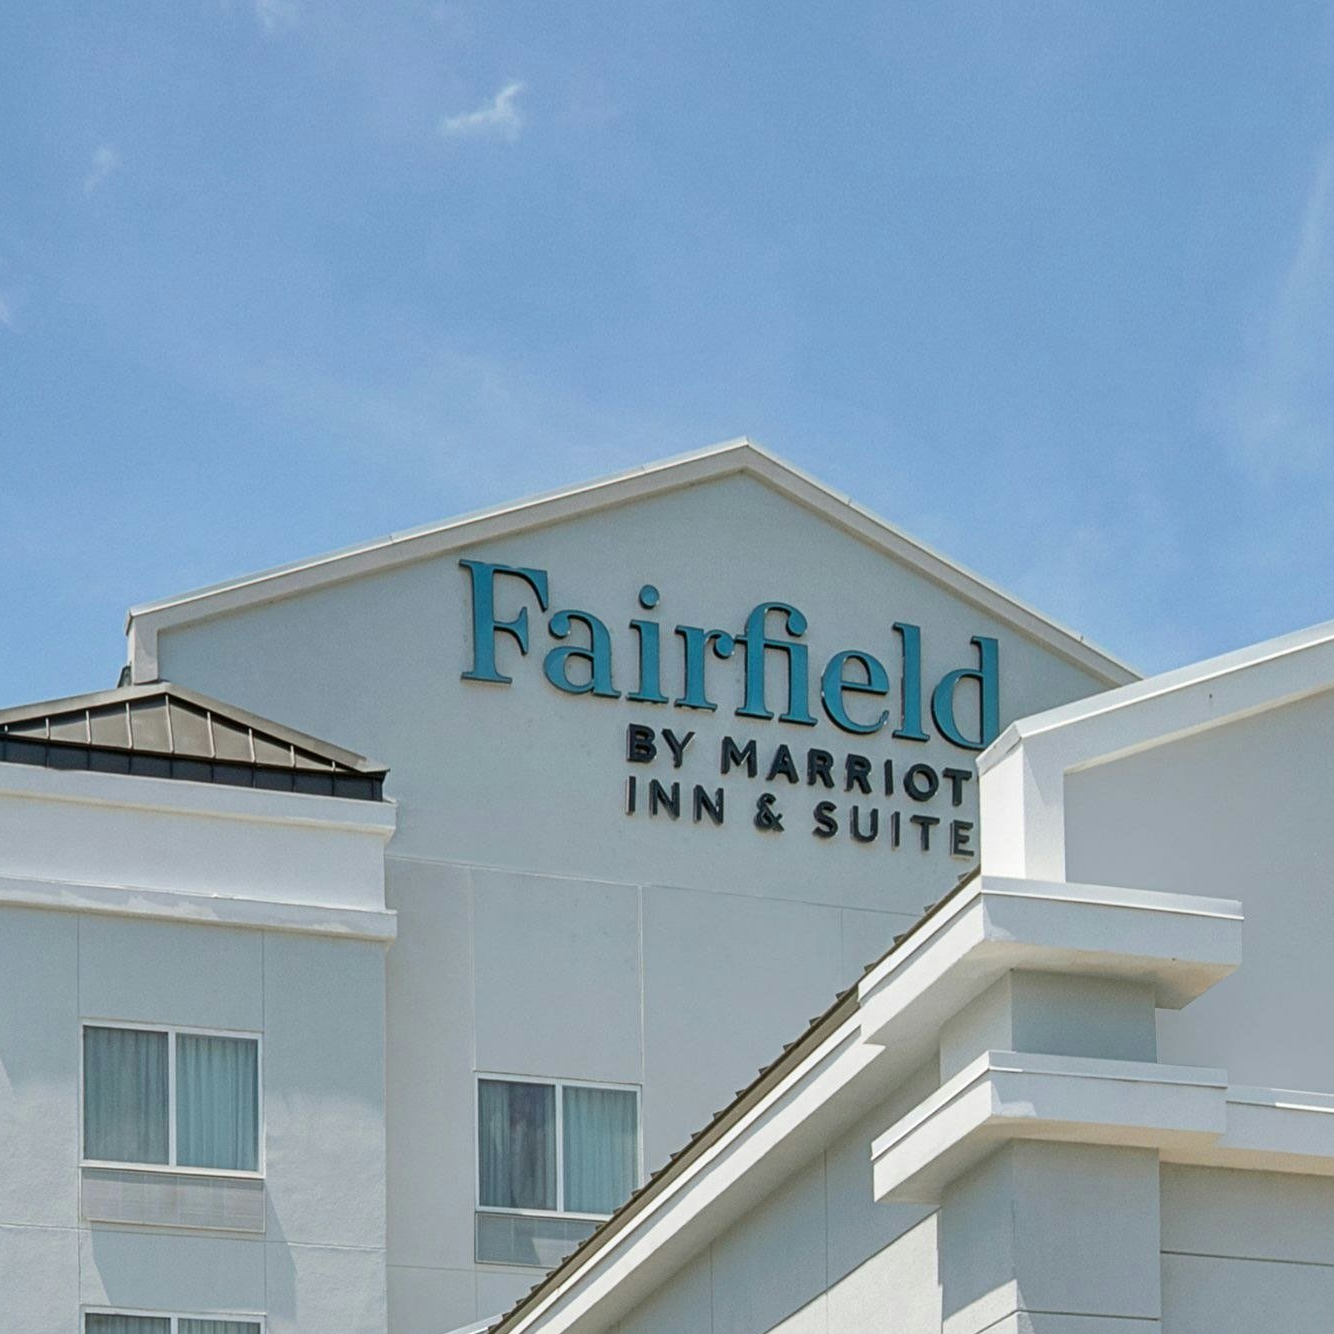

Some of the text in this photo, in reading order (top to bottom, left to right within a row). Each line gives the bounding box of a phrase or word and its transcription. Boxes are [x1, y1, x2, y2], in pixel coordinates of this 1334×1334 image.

[459, 558, 1000, 751] Fairfield
[626, 723, 979, 807] BY MARRIOT
[625, 775, 975, 859] INN & SUITE
